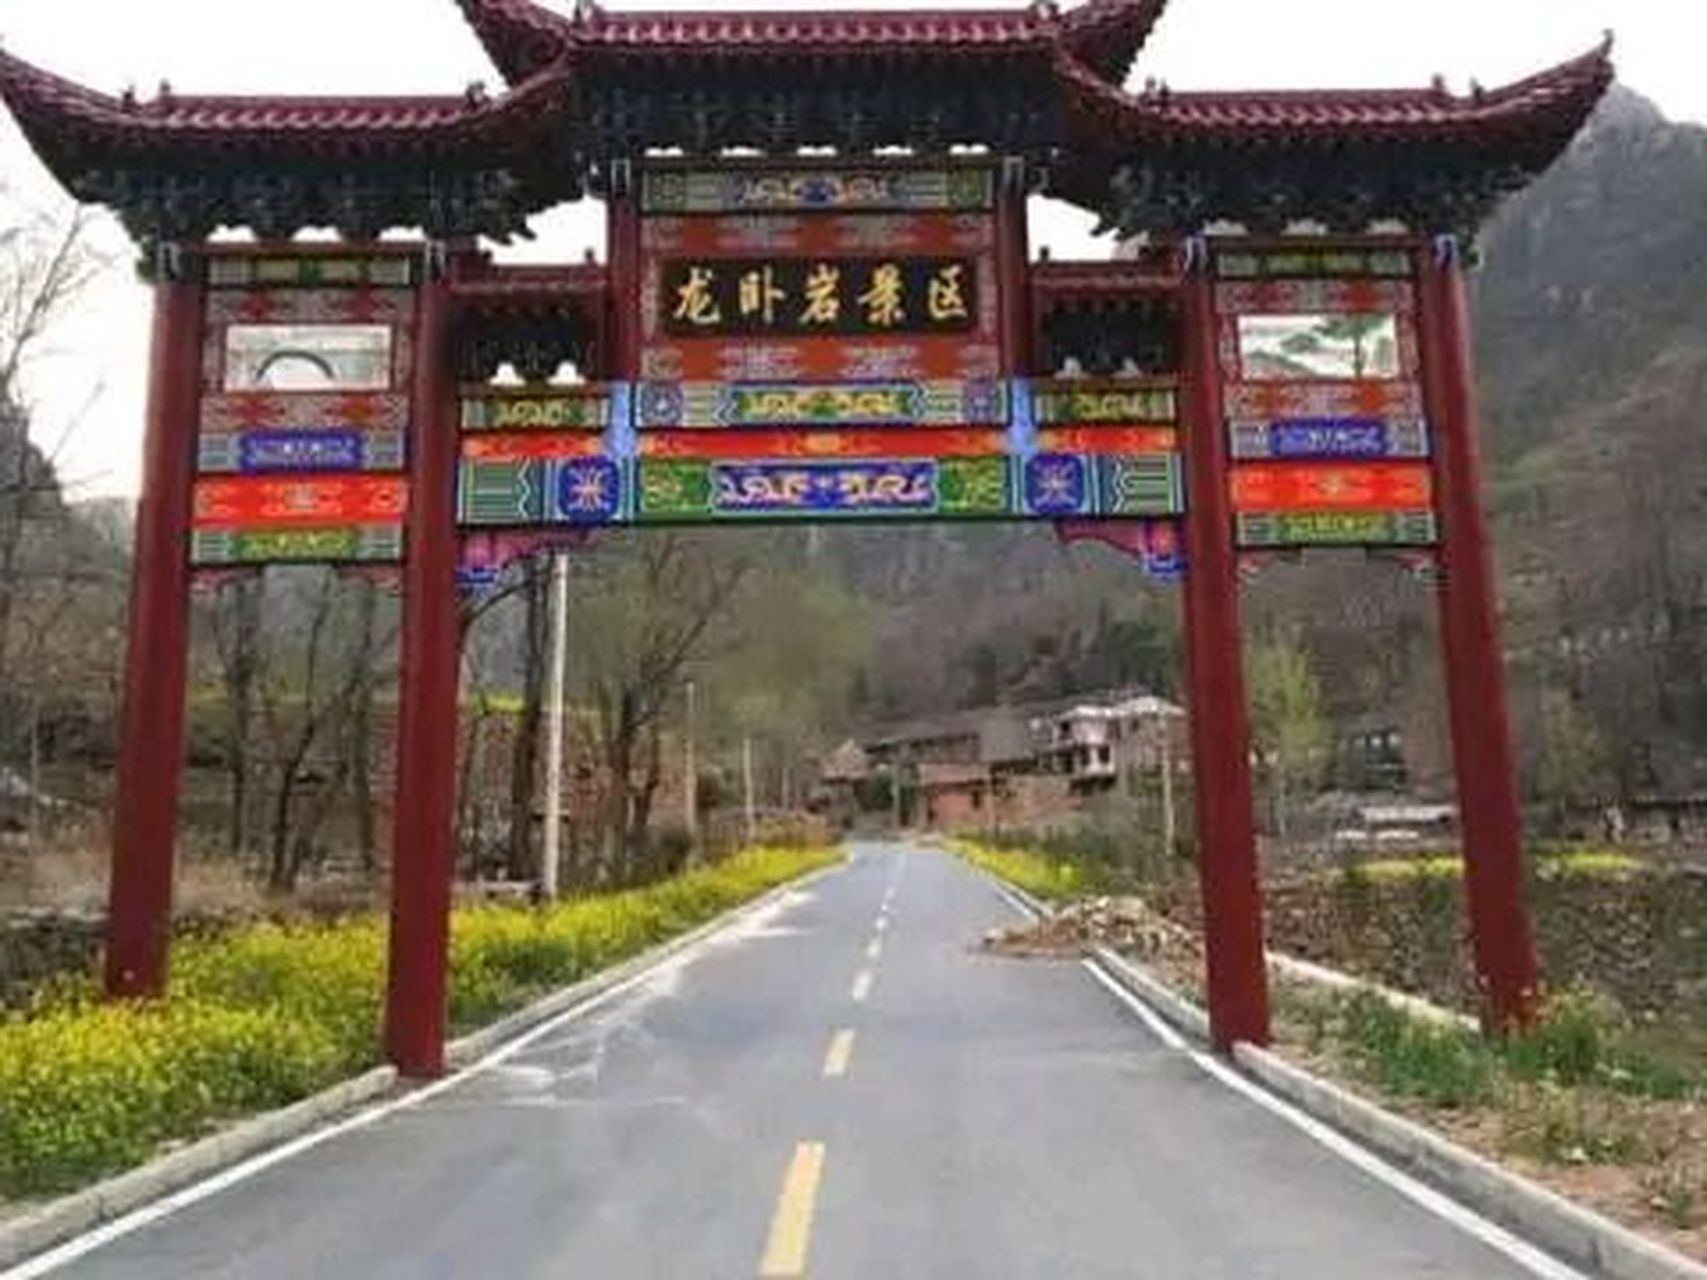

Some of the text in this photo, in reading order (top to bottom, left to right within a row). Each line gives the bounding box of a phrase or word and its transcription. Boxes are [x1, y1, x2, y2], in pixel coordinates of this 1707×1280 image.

[672, 262, 969, 325] 龙卧岩景区
